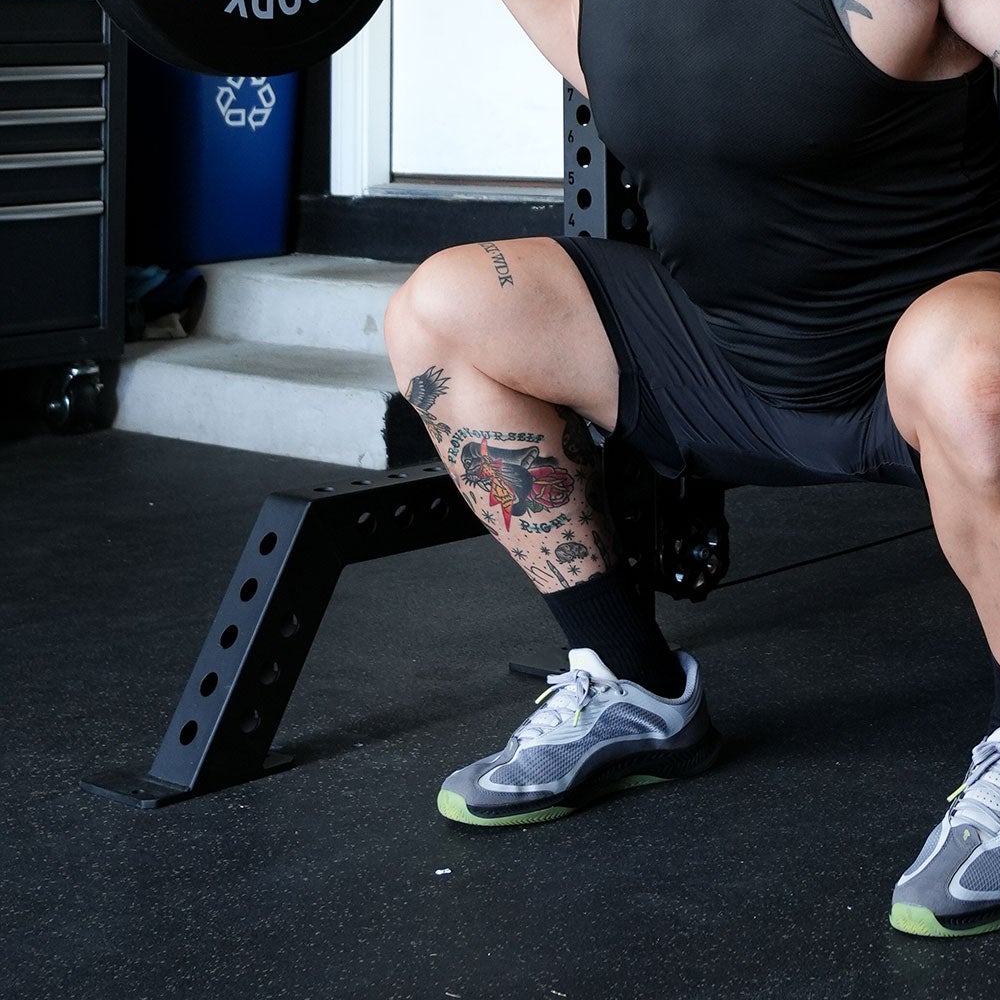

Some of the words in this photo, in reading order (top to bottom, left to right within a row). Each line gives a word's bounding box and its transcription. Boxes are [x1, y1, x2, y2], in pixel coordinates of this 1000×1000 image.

[567, 88, 574, 101] 7
[568, 129, 574, 143] 6
[568, 172, 575, 185] 5
[568, 213, 575, 228] 4
